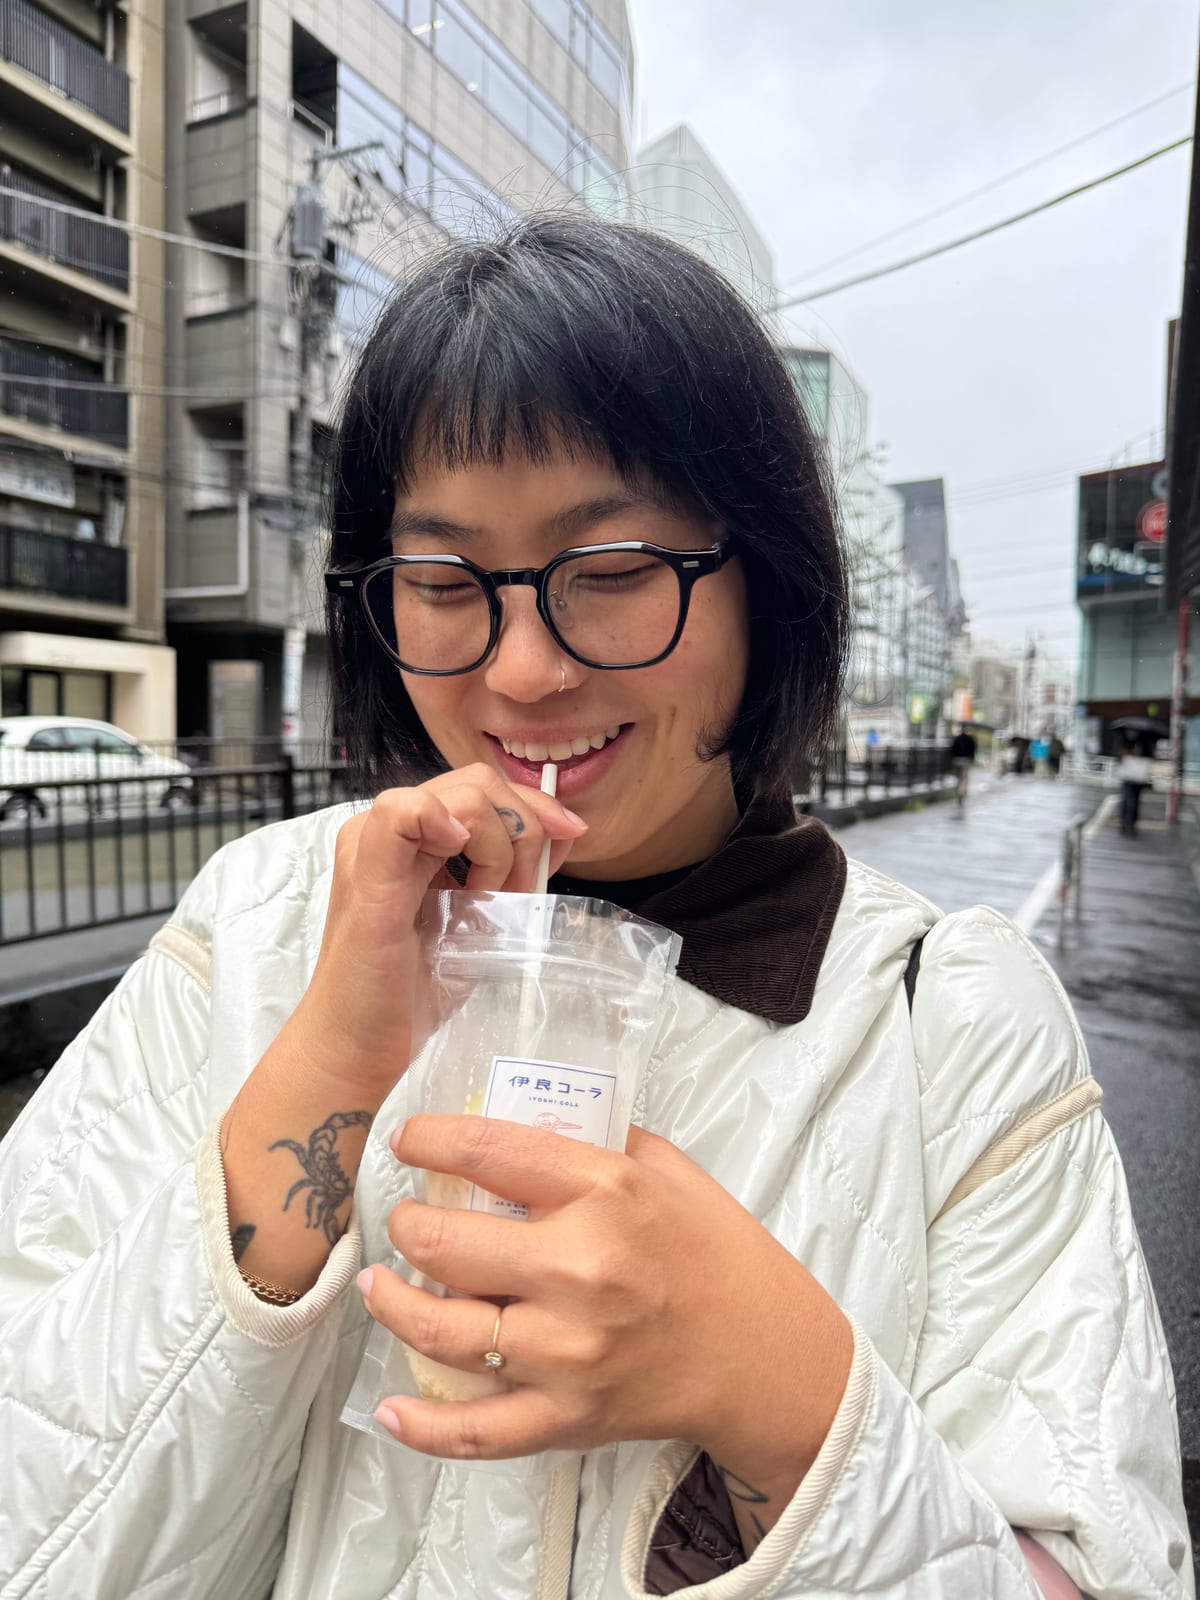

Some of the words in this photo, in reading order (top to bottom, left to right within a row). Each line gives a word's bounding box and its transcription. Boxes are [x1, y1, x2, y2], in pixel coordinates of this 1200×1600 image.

[508, 1075, 602, 1098] 伊良コーラ
